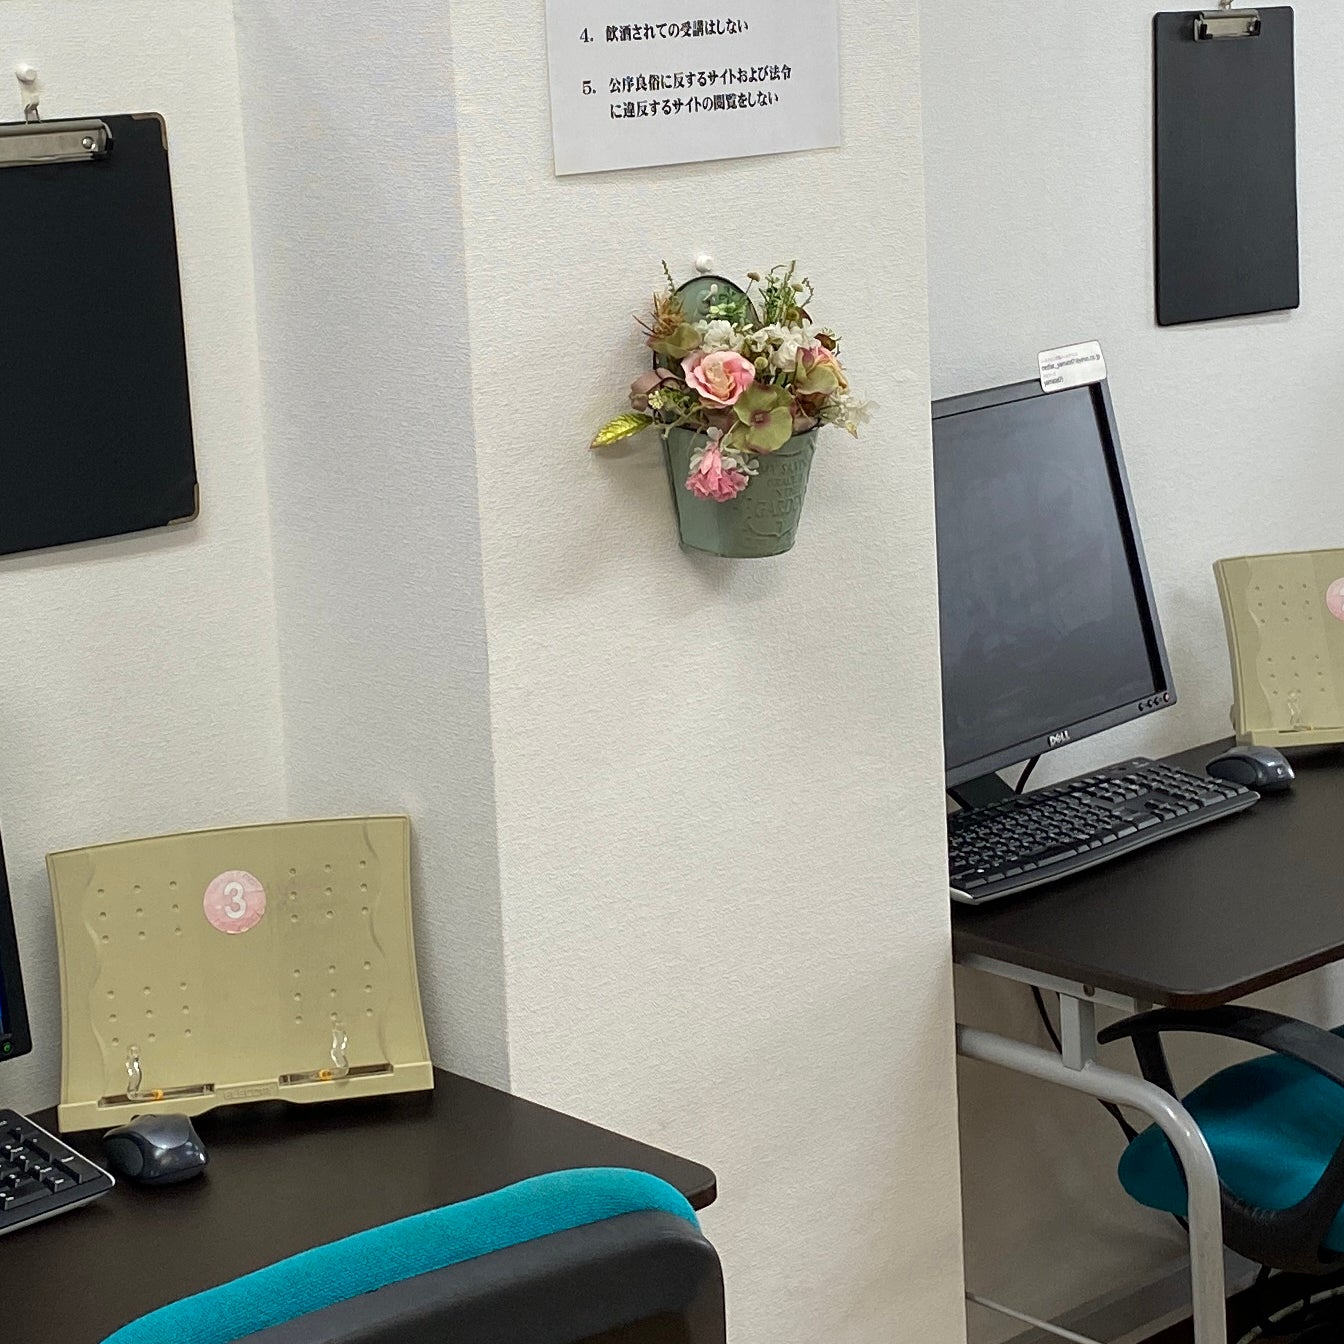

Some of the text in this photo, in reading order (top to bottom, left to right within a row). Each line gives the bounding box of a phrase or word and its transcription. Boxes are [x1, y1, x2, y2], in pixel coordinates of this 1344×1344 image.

[579, 19, 749, 43] 4. 飲酒されての受講はしない
[582, 64, 792, 95] 5. 公序良俗に反するサイトおよび法令
[610, 91, 779, 119] に違反するサイトの閲覧をしない
[1047, 730, 1070, 747] DELL
[223, 881, 247, 919] 3
